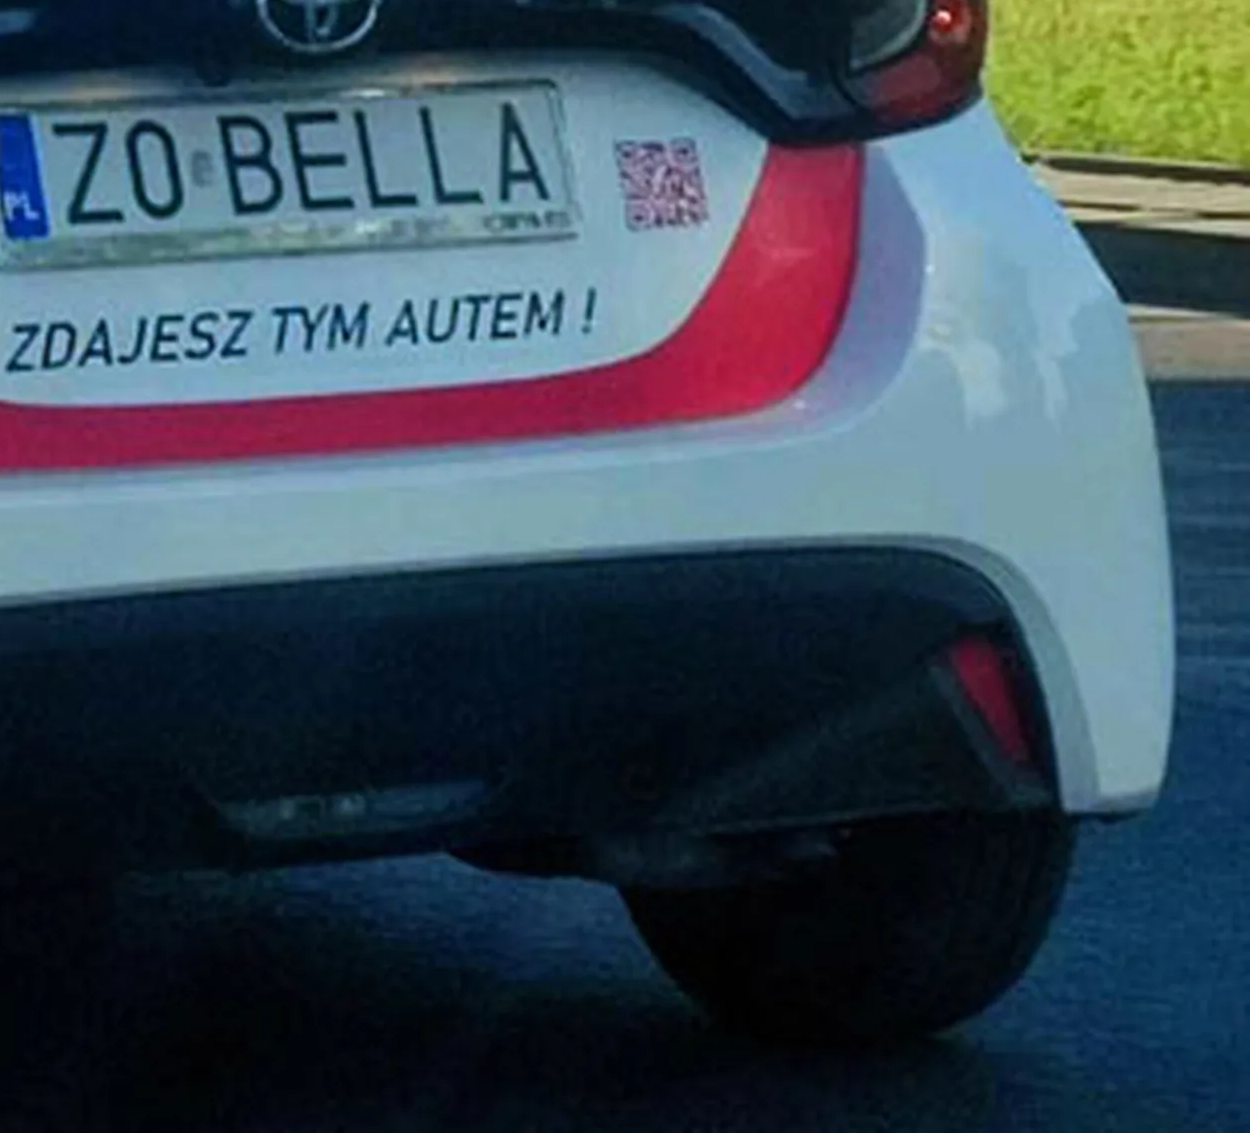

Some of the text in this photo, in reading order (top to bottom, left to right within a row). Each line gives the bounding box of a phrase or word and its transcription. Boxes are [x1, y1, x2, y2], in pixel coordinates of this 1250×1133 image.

[3, 190, 40, 220] PL
[216, 102, 550, 215] BELLA
[6, 310, 254, 373] ZDAJESZ
[271, 300, 370, 354] TYM
[384, 289, 565, 347] AUTEM
